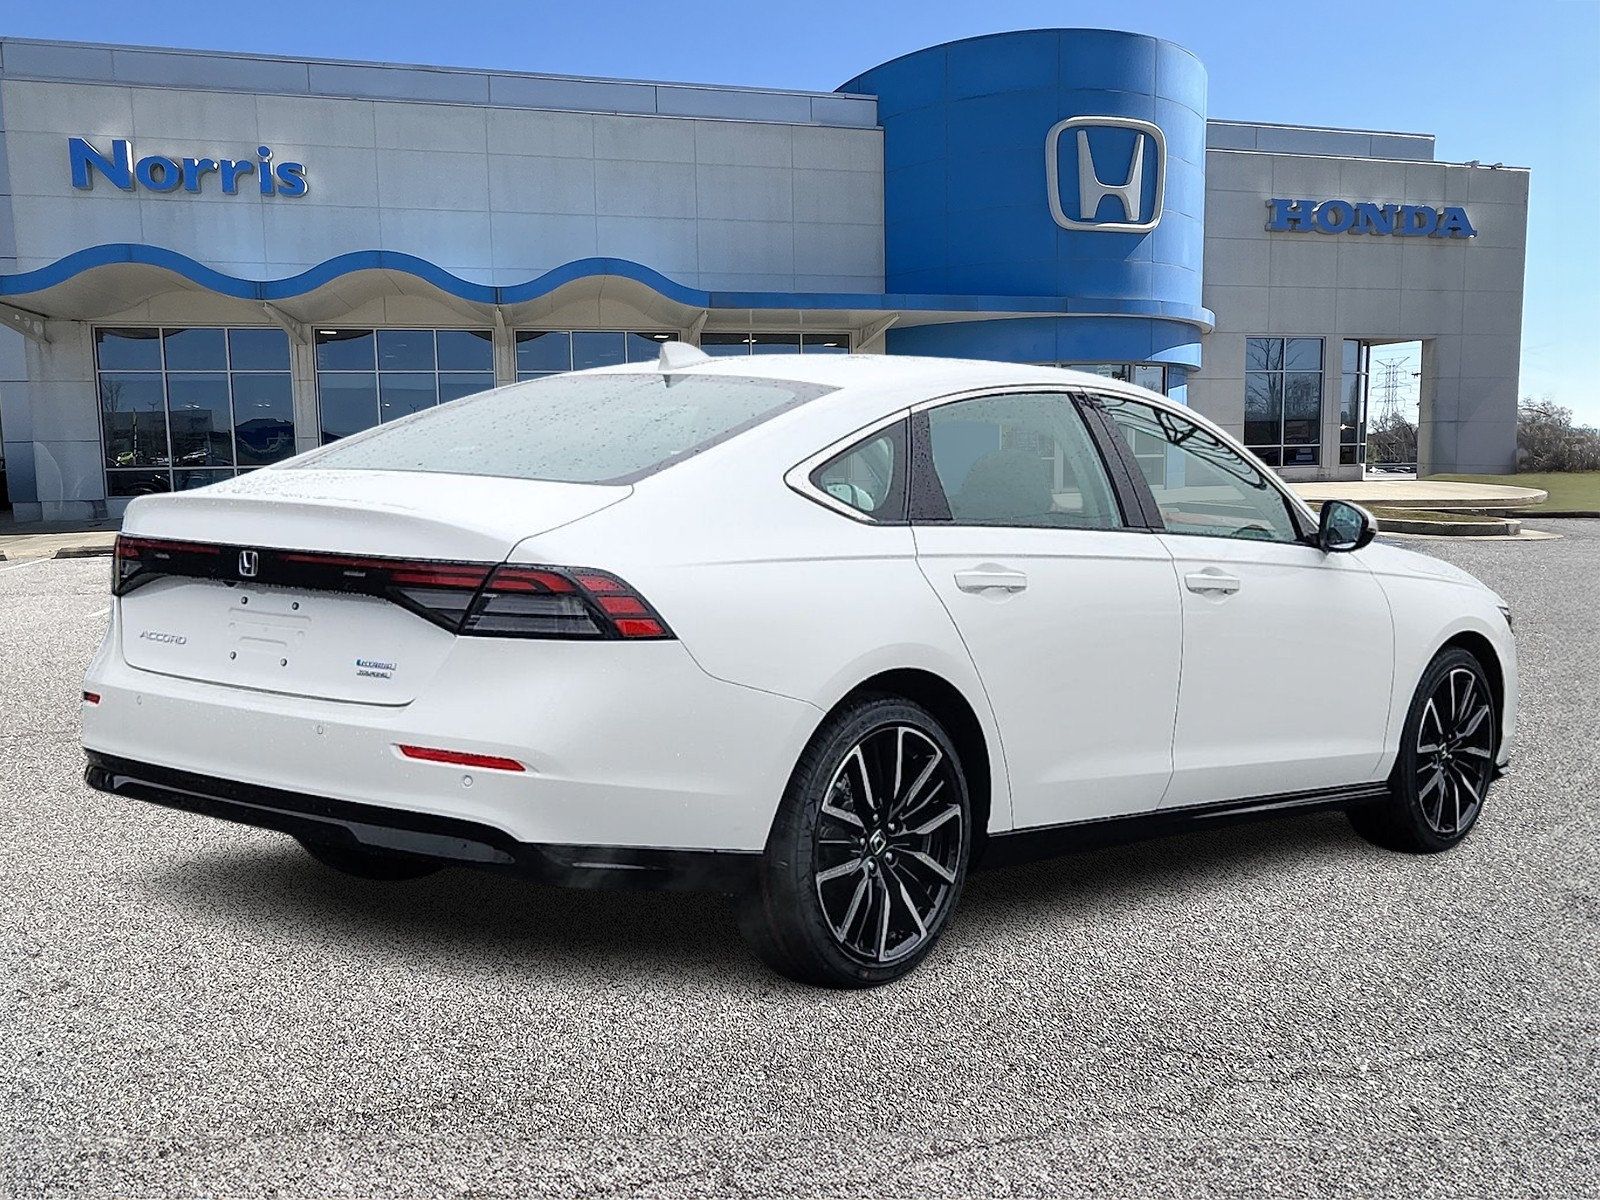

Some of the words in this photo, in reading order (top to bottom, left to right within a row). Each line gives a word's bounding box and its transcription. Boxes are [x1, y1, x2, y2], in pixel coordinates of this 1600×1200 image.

[68, 137, 308, 197] Norris
[1265, 198, 1477, 238] HONDA
[139, 630, 187, 645] ACCORD
